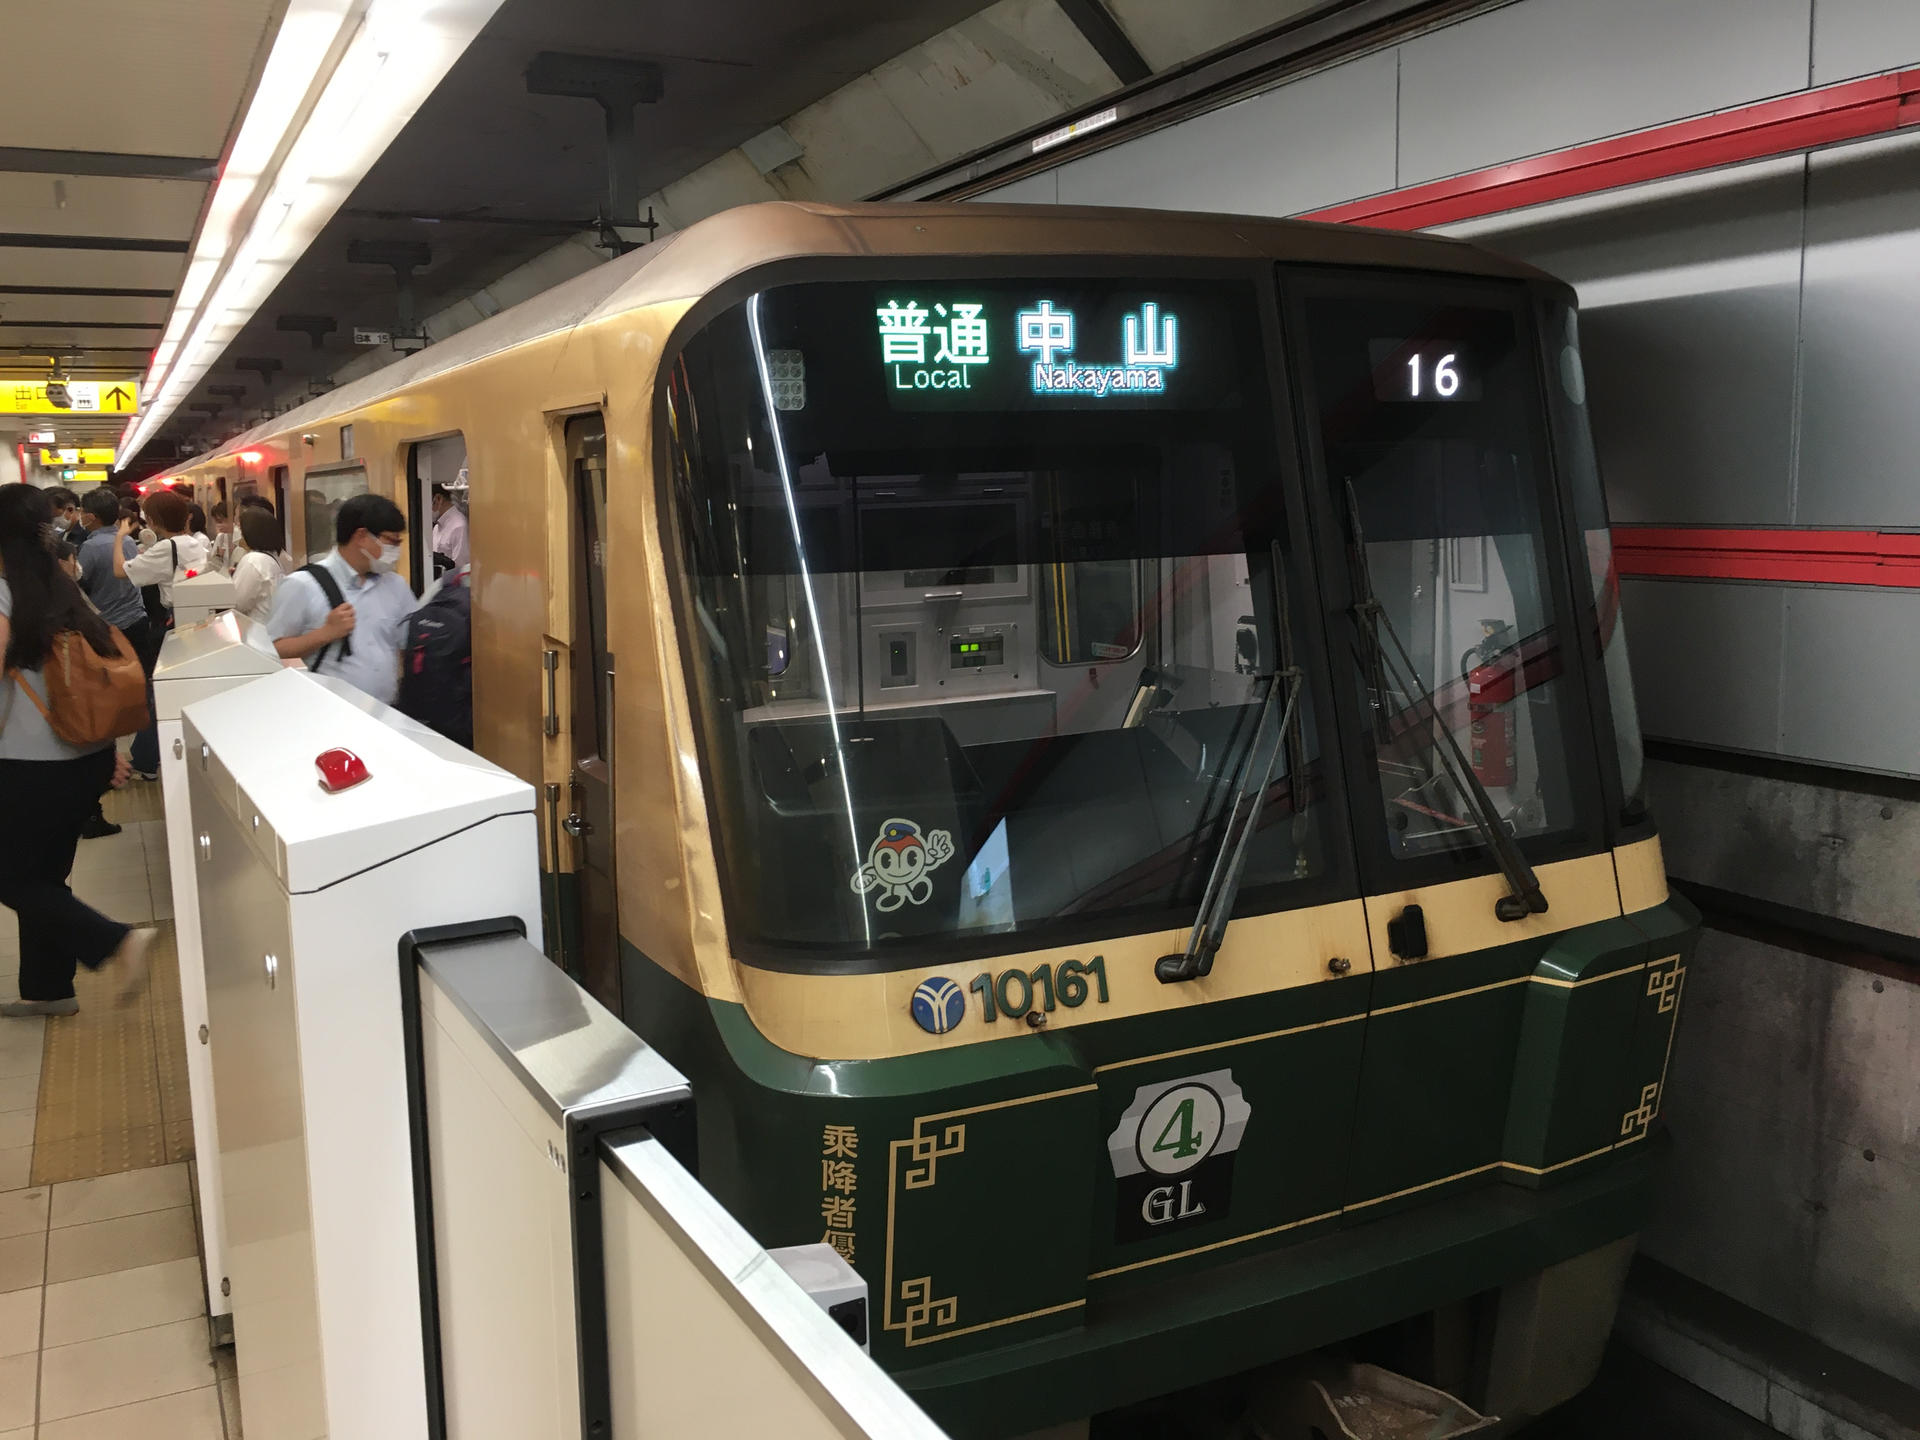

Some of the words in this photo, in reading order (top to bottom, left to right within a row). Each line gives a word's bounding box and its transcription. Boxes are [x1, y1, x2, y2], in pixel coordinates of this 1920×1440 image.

[377, 334, 388, 344] 15
[876, 299, 989, 364] 普通
[895, 364, 971, 389] Local
[1035, 362, 1163, 395] Nakayama
[1408, 353, 1459, 397] 16
[970, 954, 1110, 1023] 10161
[1152, 1098, 1203, 1159] 4
[1141, 1179, 1206, 1226] GL
